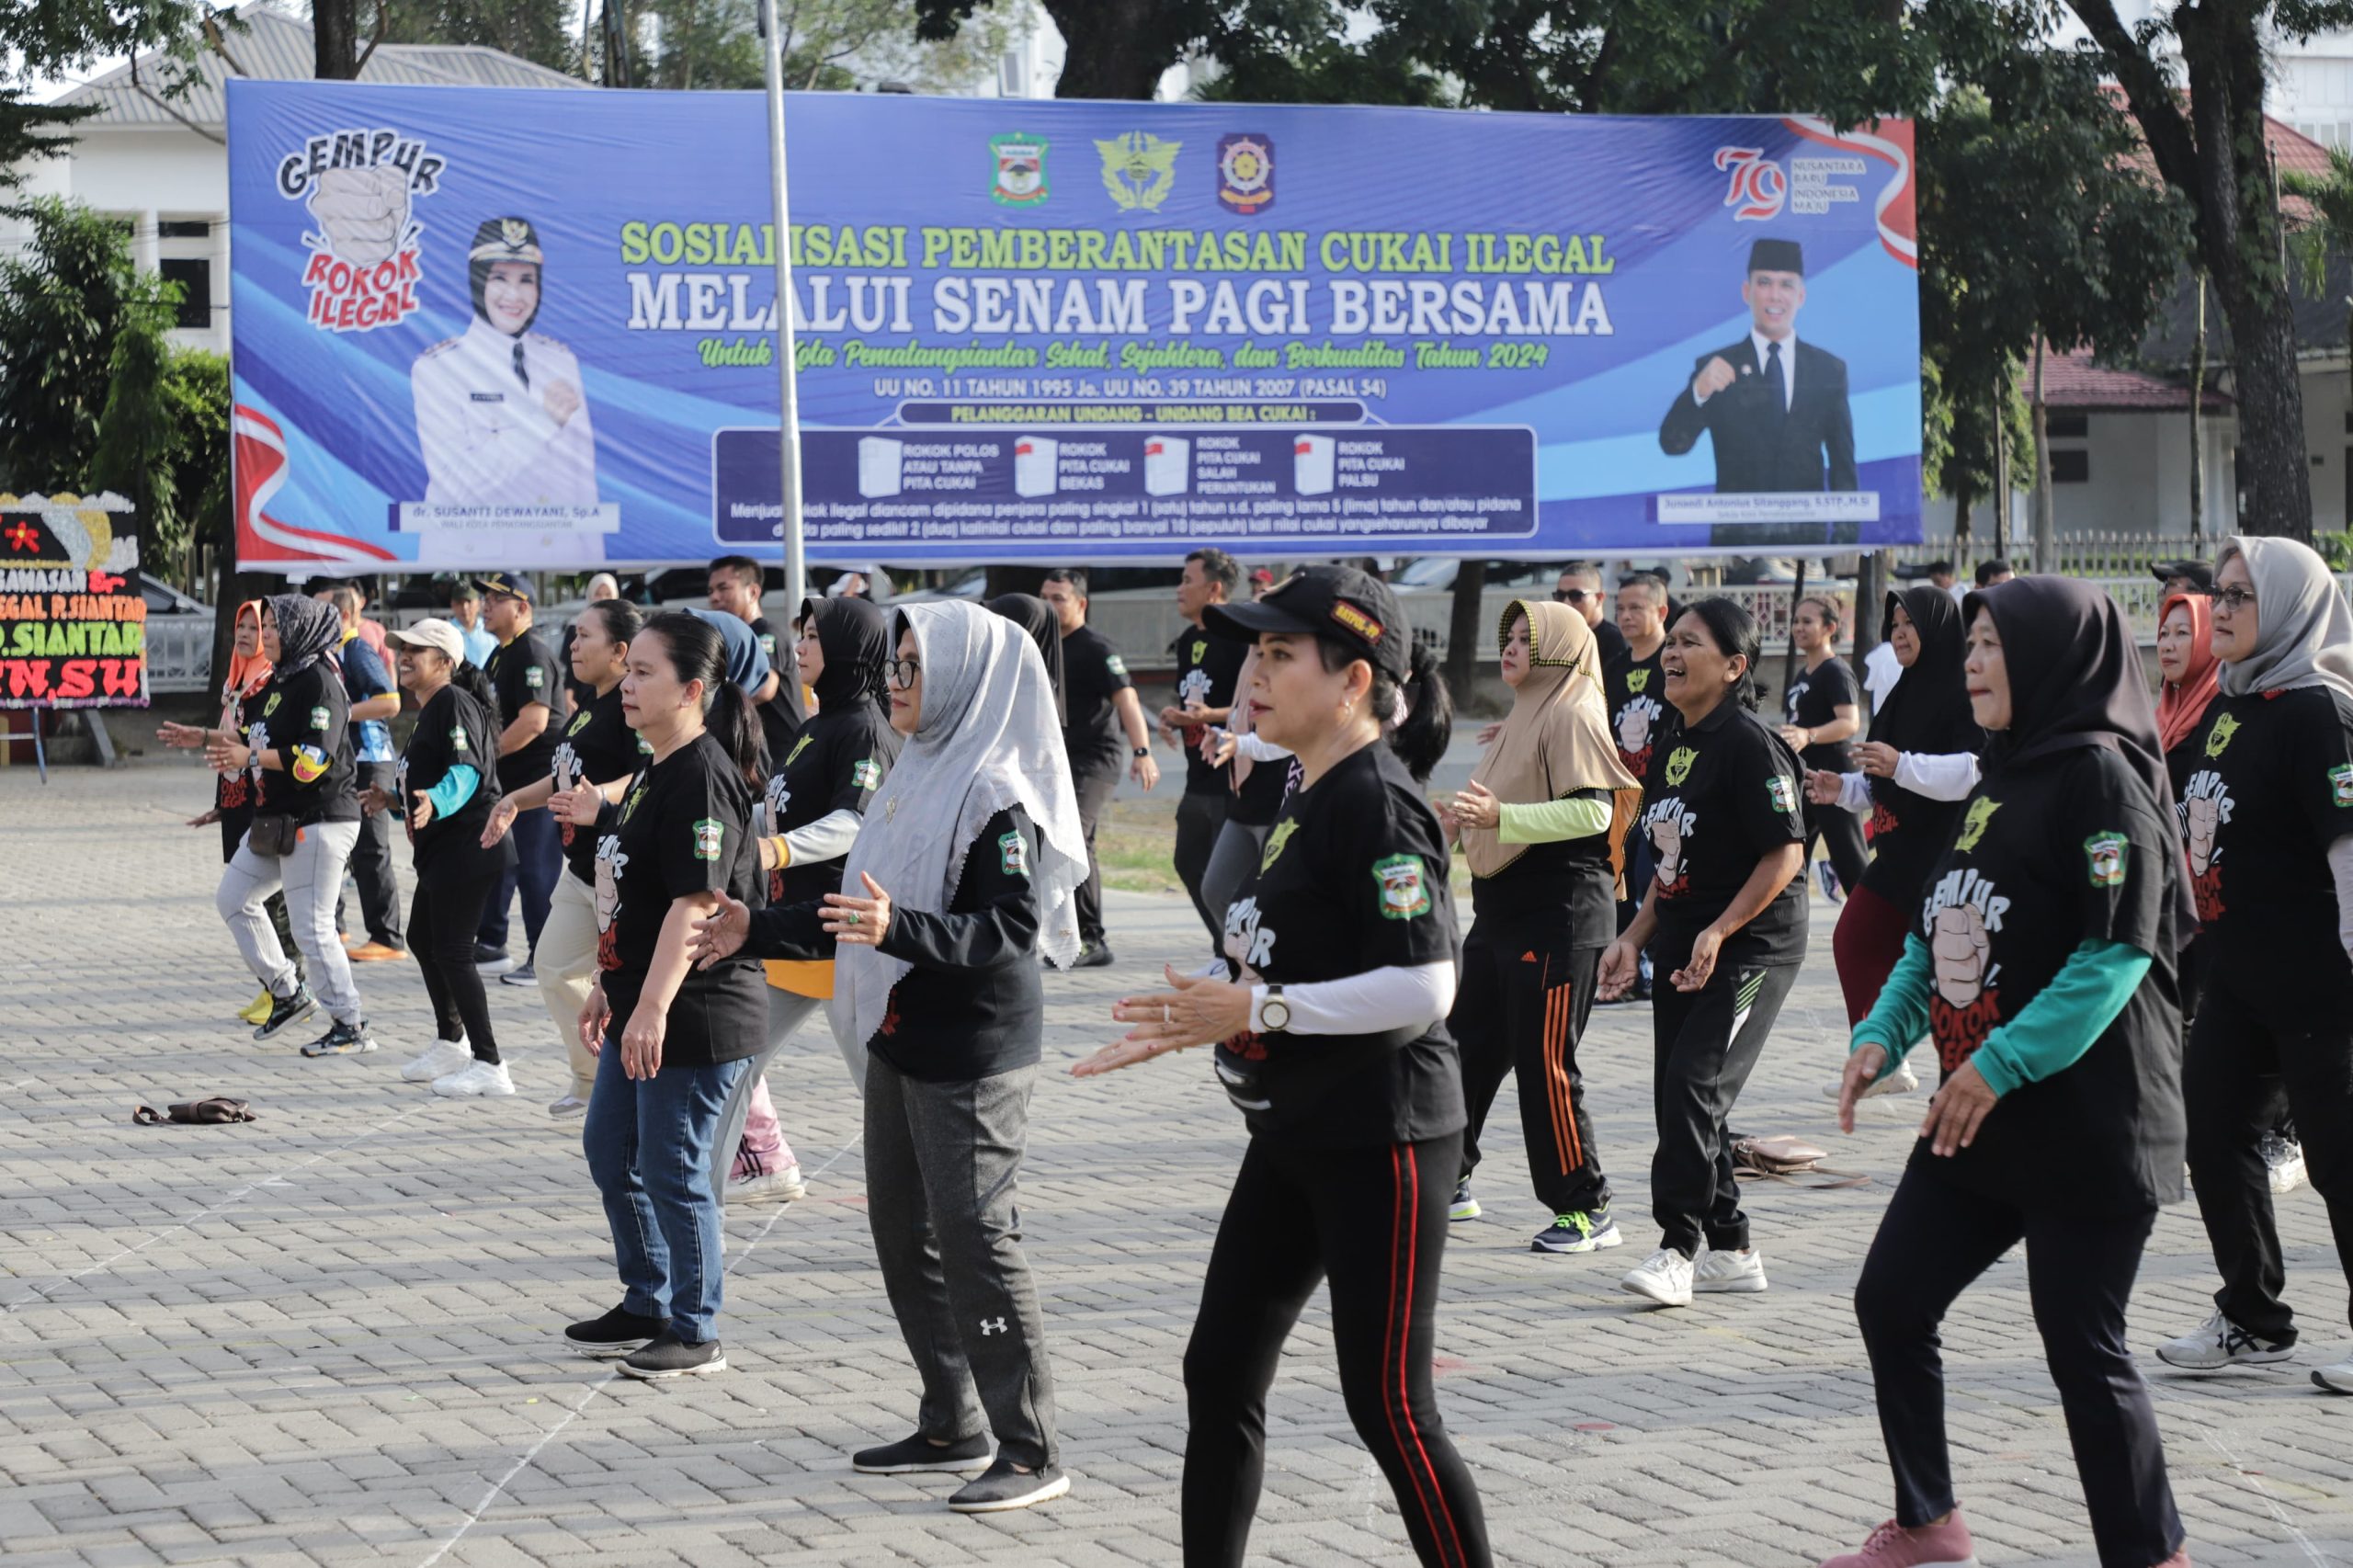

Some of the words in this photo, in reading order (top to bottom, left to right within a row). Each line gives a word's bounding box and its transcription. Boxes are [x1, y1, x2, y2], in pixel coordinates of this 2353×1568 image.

[280, 131, 442, 195] GEMPUR
[1793, 160, 1864, 173] NUSANTARA
[1714, 146, 1785, 222] 79
[1793, 187, 1858, 199] INDONESIA
[922, 227, 1306, 272] PEMBERANTASAN
[1320, 232, 1452, 273] CUKAI
[1465, 233, 1615, 275] ILEGAL
[306, 249, 418, 297] ROKOK
[312, 281, 416, 328] ILEGAL
[933, 277, 1149, 335] SENAM
[1168, 278, 1311, 335] PAGI
[1329, 280, 1613, 335] BERSAMA
[698, 338, 773, 368] Untuk
[843, 339, 1038, 375] Pematangsiantar
[1045, 340, 1111, 369] Sehat,
[1120, 341, 1227, 375] Sejahtera,
[1233, 341, 1279, 368] dan
[1284, 340, 1404, 369] Berkualitas
[1413, 341, 1482, 369] Tahun
[1487, 342, 1549, 369] 2024
[874, 378, 900, 397] UU
[904, 378, 937, 397] NO.
[942, 379, 961, 397] 11
[966, 379, 1027, 397] TAHUN
[1032, 379, 1073, 397] 1995
[1104, 379, 1129, 397] UU
[1131, 379, 1165, 397] NO.
[1168, 379, 1190, 397] 39
[1192, 379, 1251, 397] TAHUN
[1255, 378, 1296, 396] 2007
[1299, 378, 1357, 398] (PASAL
[951, 405, 1071, 423] PELANGGARAN
[1074, 405, 1142, 423] UNDANG
[1154, 405, 1223, 423] UNDANG
[1226, 405, 1256, 422] BEA
[1258, 405, 1307, 421] CUKAI
[1059, 443, 1107, 457] ROKOK
[1197, 437, 1240, 449] ROKOK
[1337, 441, 1383, 455] ROKOK
[903, 444, 952, 458] ROKOK
[953, 444, 1000, 458] POLOS
[1224, 451, 1261, 464] CUKAI
[1059, 460, 1087, 473] PITA
[1088, 460, 1131, 473] CUKAI
[1367, 458, 1405, 471] CUKAI
[903, 476, 934, 490] PITA
[934, 476, 977, 490] CUKAI
[1059, 476, 1105, 490] BEKAS
[1337, 473, 1379, 487] PALSU
[434, 506, 491, 517] SUSANTI
